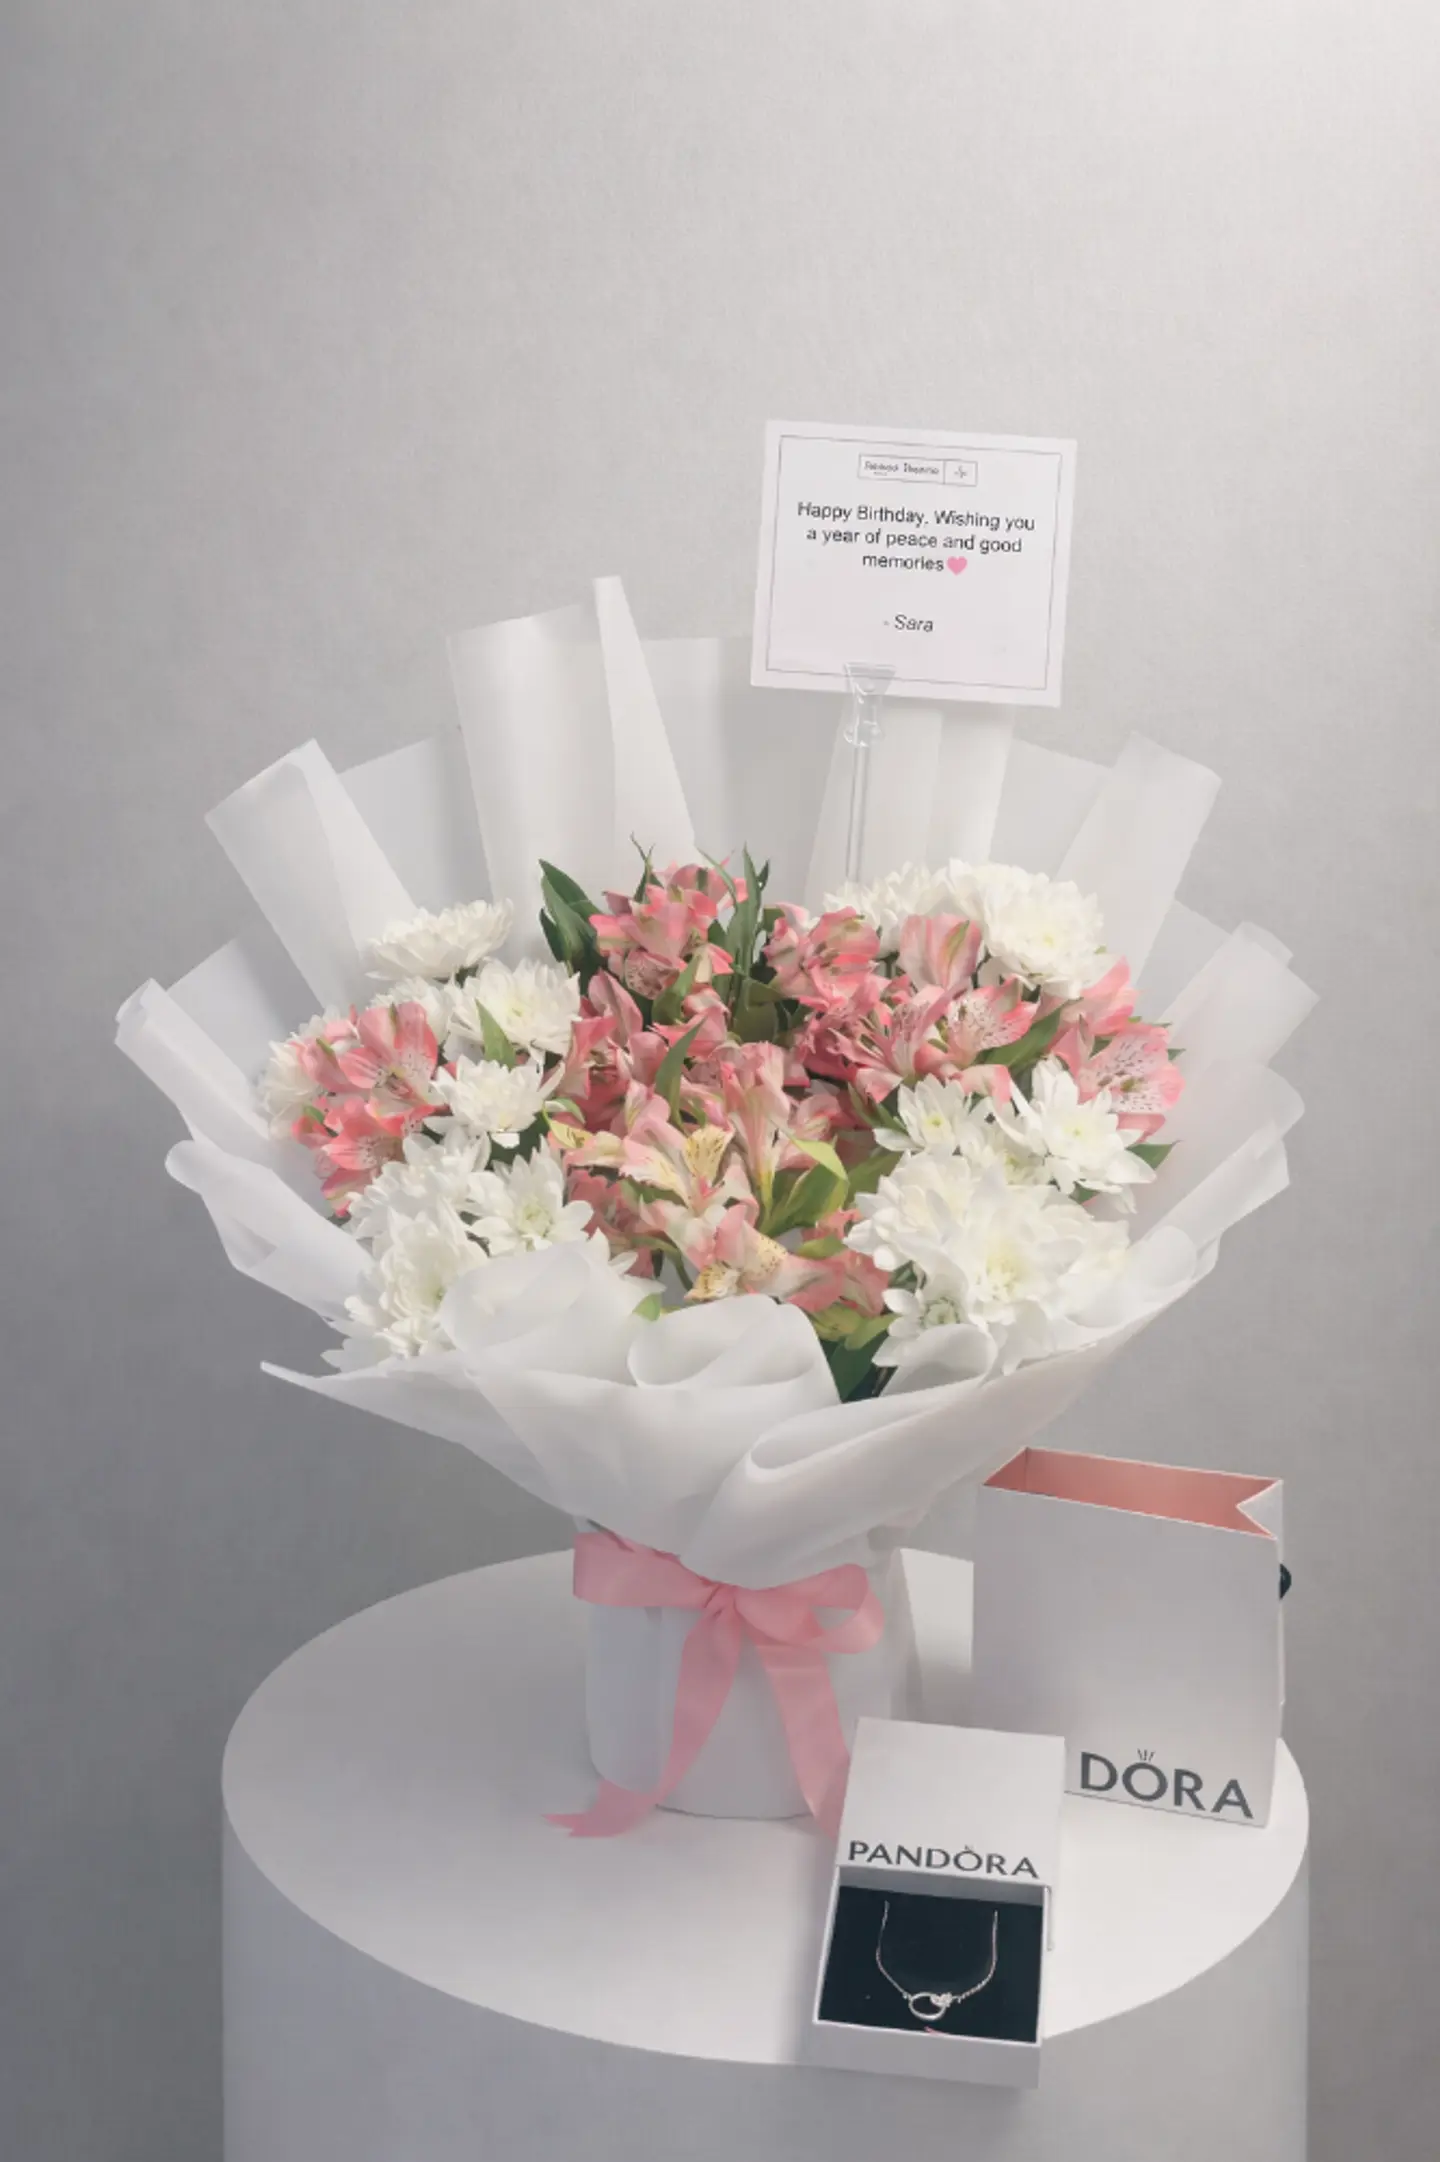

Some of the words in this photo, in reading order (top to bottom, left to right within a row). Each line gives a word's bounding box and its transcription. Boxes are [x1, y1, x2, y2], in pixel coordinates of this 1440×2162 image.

[797, 501, 852, 522] Happy
[934, 511, 1000, 531] Wishing
[1005, 517, 1035, 531] you
[806, 529, 817, 540] a
[823, 531, 859, 545] year
[865, 529, 881, 544] of
[886, 533, 937, 548] peace
[943, 534, 975, 550] and
[980, 538, 1022, 554] good
[862, 554, 944, 571] memories
[894, 615, 933, 632] Sara
[1080, 1750, 1253, 1819] DORA
[848, 1841, 1039, 1878] PANDORA
